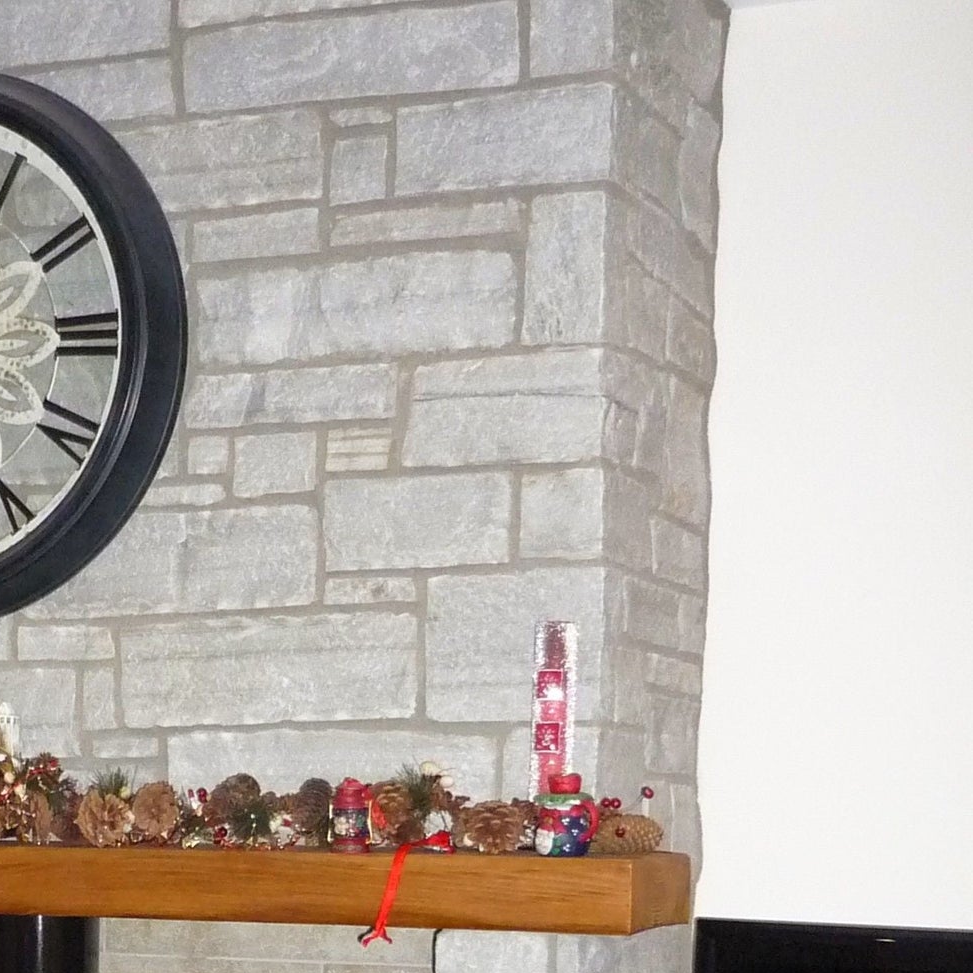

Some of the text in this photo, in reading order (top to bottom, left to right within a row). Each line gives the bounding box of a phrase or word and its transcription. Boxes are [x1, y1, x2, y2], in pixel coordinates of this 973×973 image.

[30, 212, 98, 274] II
[54, 308, 118, 360] III
[36, 396, 101, 470] IV
